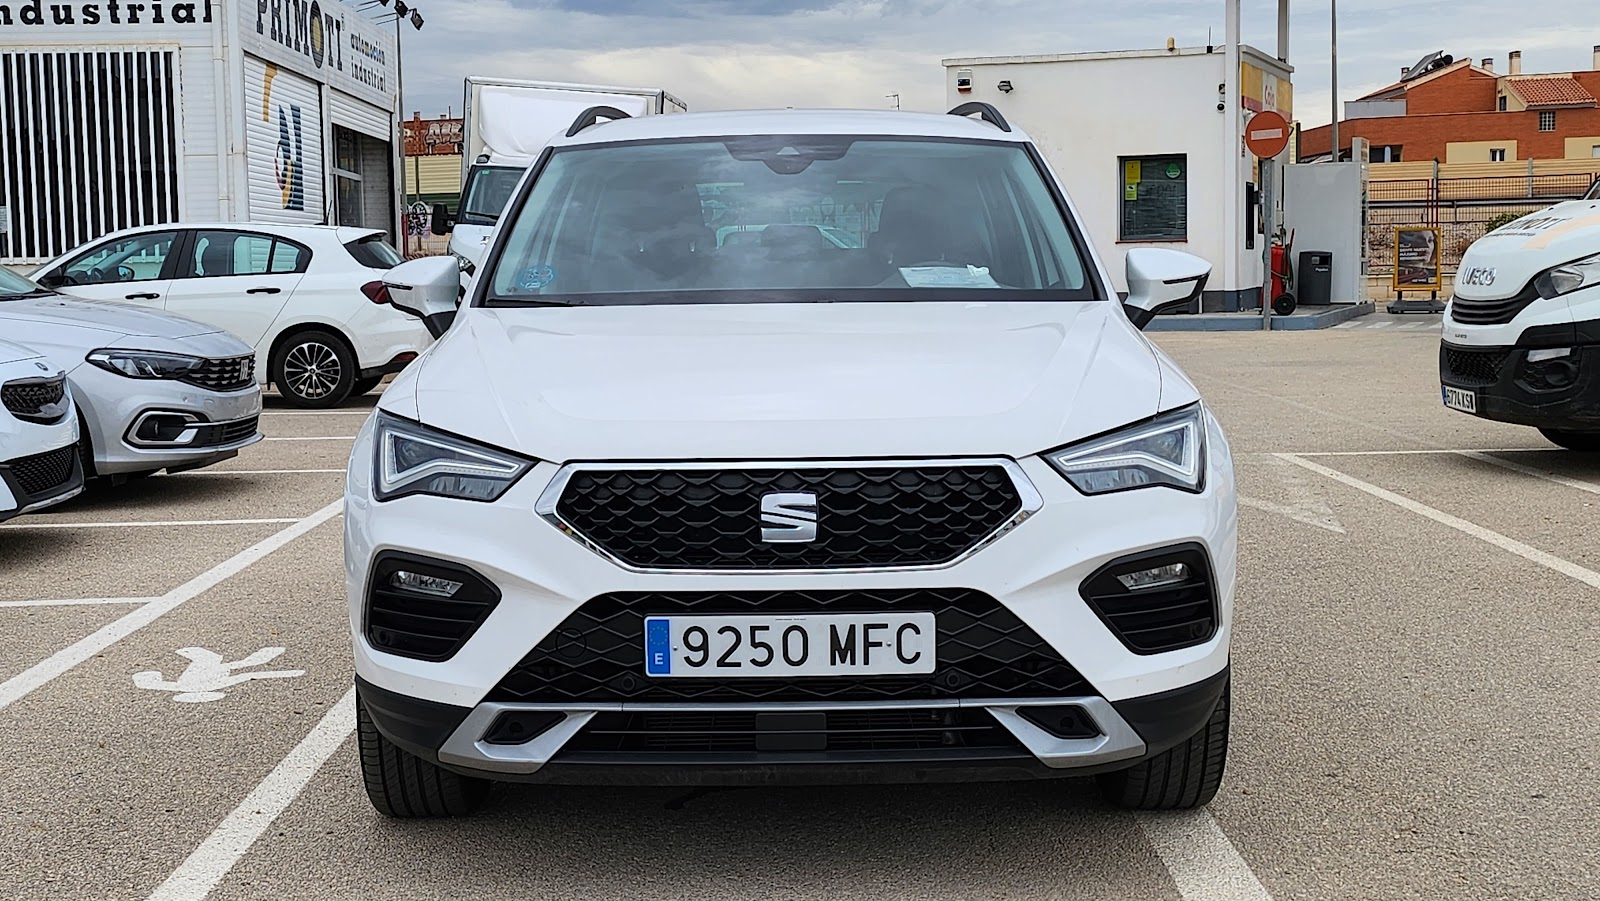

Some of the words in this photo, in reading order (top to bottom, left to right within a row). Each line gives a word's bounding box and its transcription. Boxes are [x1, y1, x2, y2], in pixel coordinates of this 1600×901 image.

[351, 55, 387, 93] industrial
[1462, 266, 1497, 286] IVECO
[655, 653, 664, 665] E
[683, 625, 809, 668] 9250
[830, 623, 921, 666] MFC
